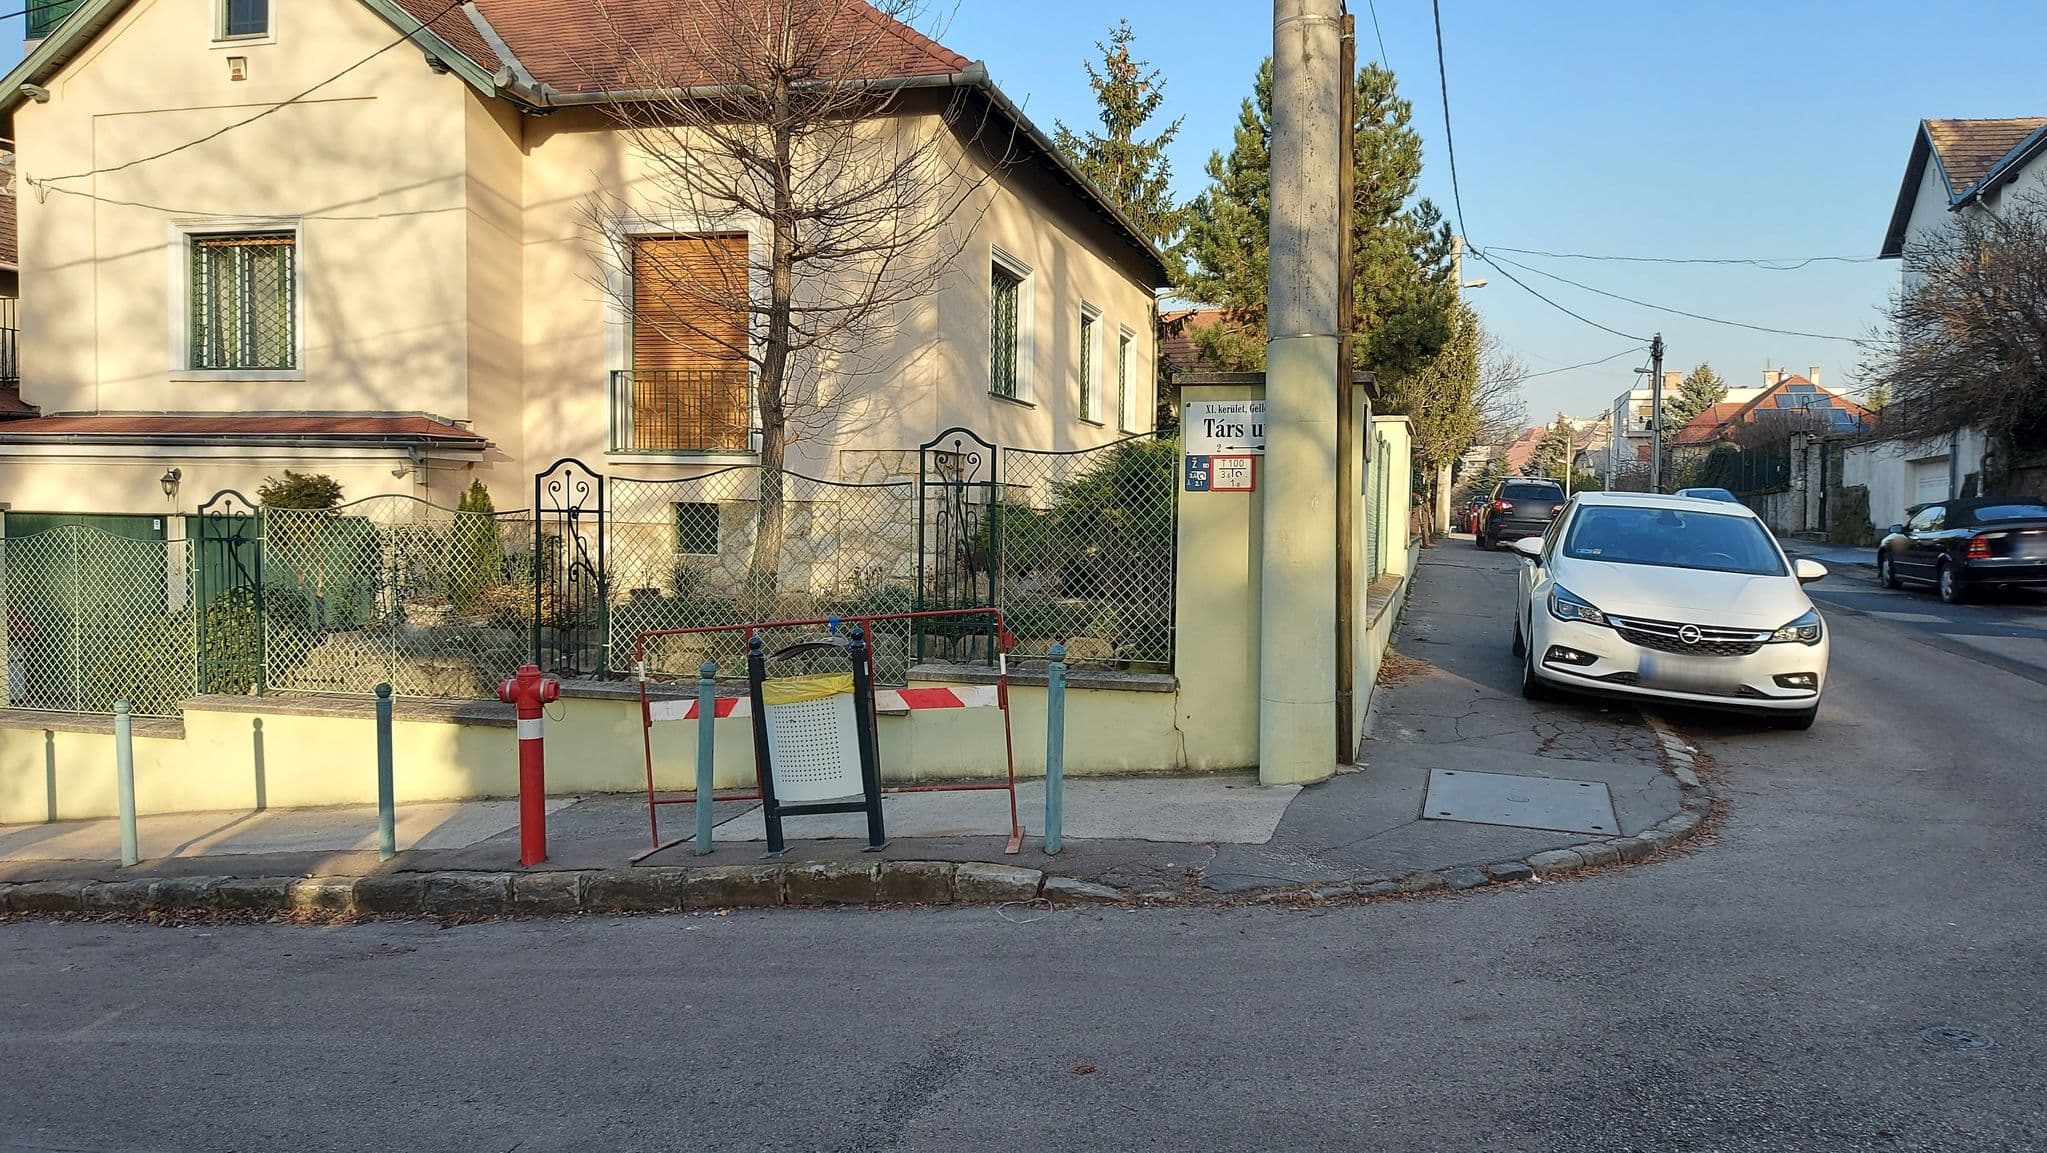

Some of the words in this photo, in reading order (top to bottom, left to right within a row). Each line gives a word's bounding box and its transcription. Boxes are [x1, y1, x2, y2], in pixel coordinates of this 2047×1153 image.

[1205, 404, 1217, 414] XI.
[1218, 404, 1248, 415] kerület,
[1249, 403, 1266, 413] Gell
[1203, 418, 1244, 438] Társ
[1252, 423, 1266, 438] u
[1216, 443, 1222, 453] 2
